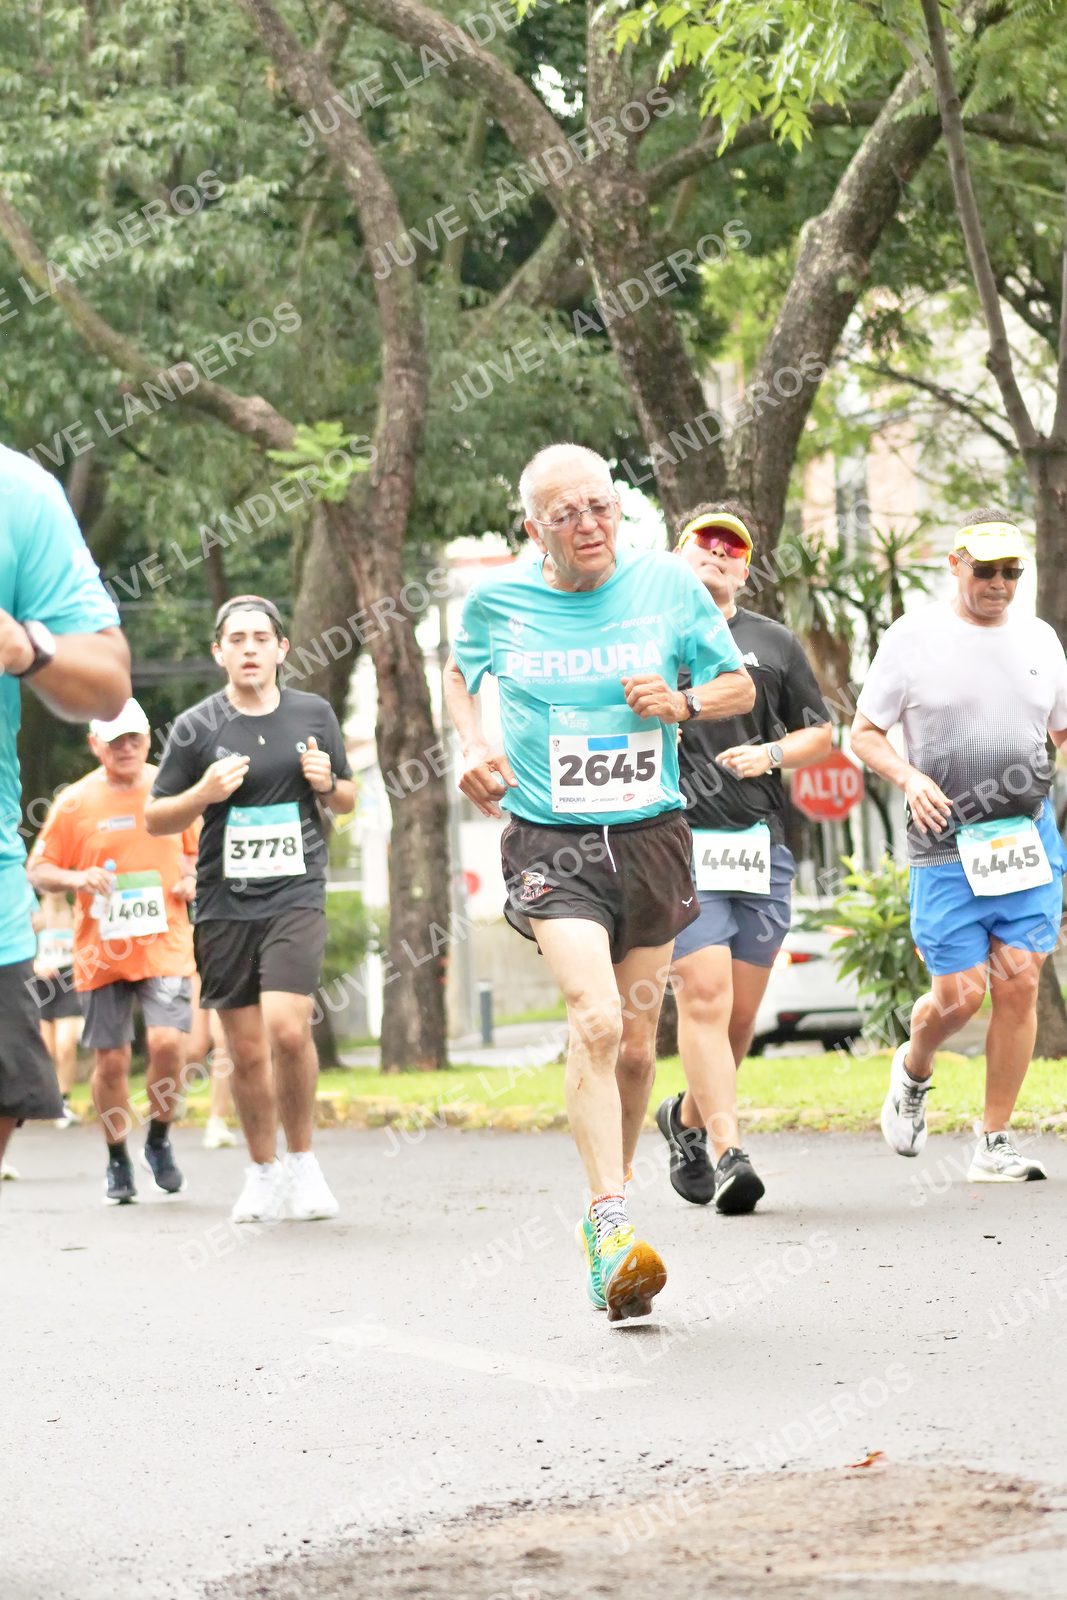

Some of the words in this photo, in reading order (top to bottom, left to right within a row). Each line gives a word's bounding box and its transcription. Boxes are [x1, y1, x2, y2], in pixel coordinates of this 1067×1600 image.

[506, 640, 662, 678] PERDURA
[558, 749, 656, 787] 2645
[799, 767, 859, 801] ALTO
[230, 836, 298, 860] 3778
[702, 849, 766, 873] 4444
[972, 845, 1040, 878] 4445
